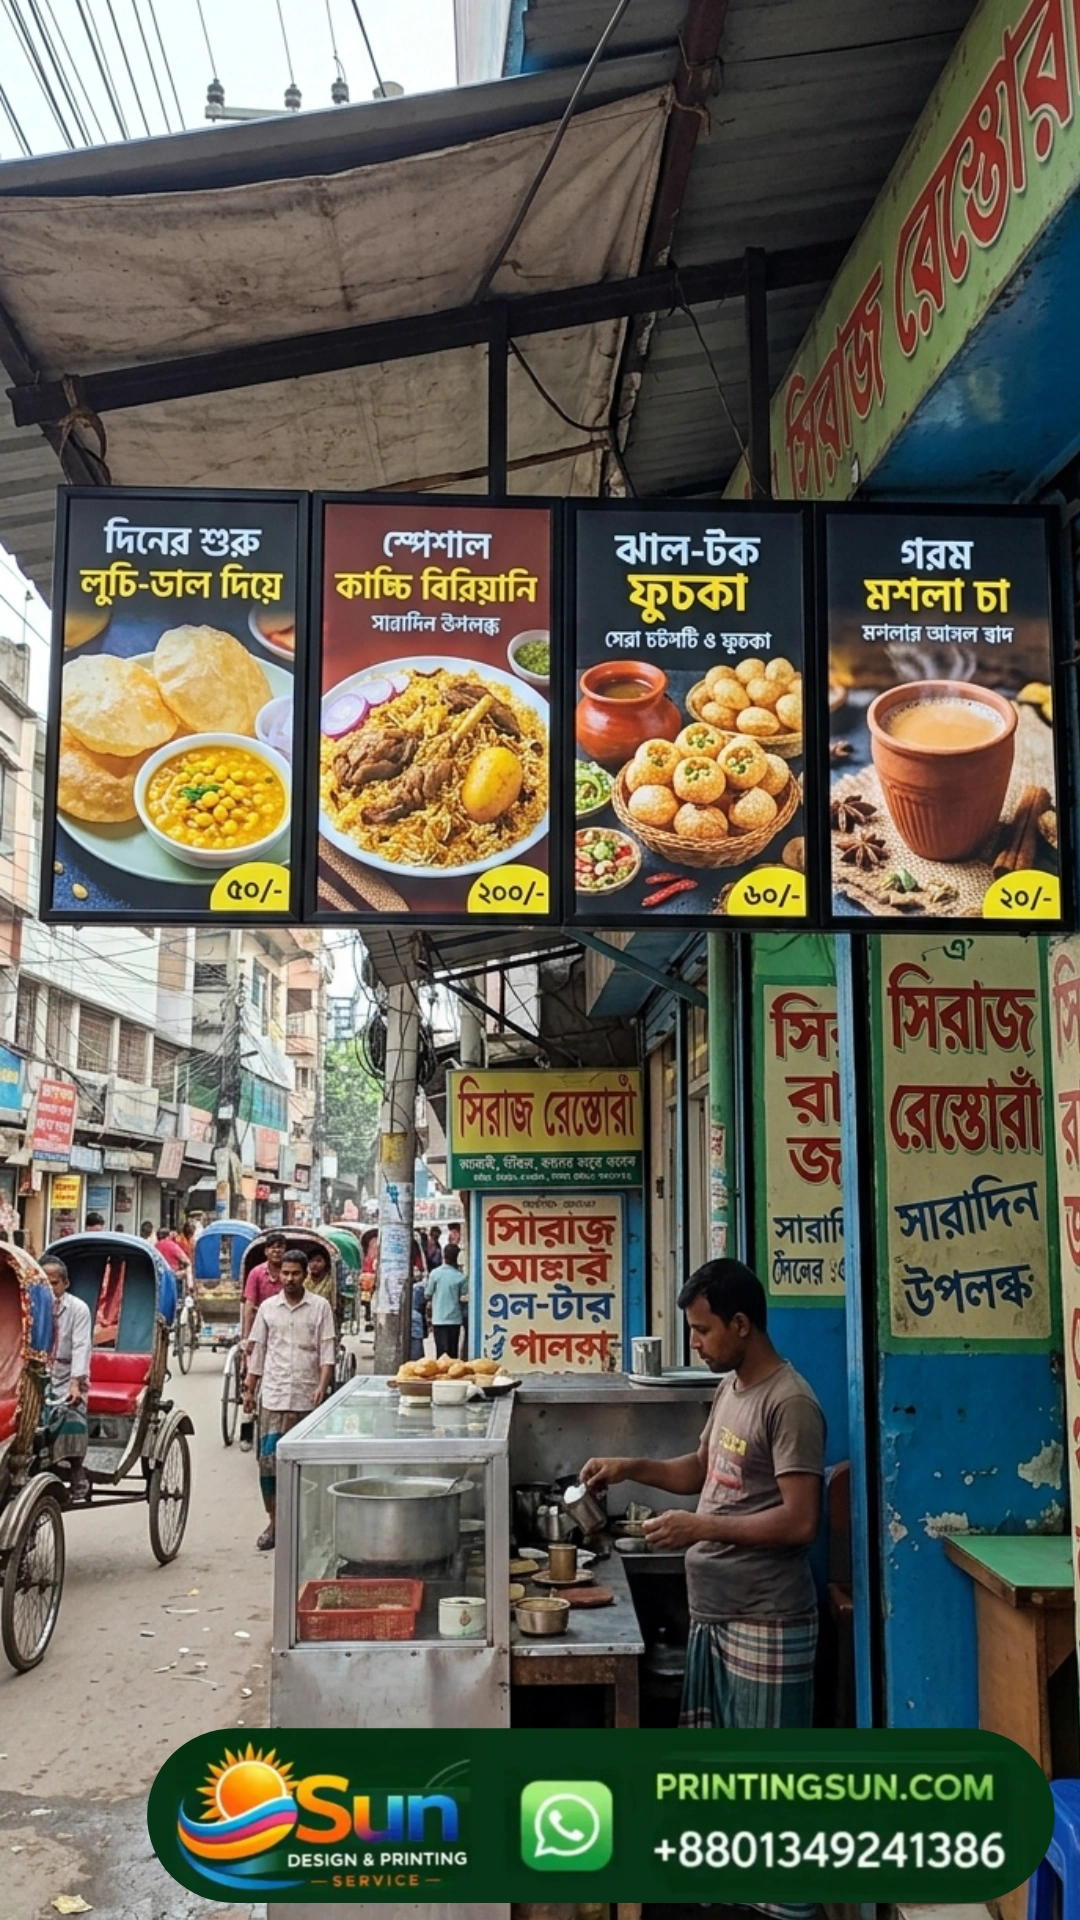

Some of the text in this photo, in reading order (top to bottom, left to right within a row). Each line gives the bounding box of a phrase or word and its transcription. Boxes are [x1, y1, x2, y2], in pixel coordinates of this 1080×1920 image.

[104, 517, 262, 557] দিনের শুরু
[383, 530, 492, 560] স্পেশাল
[614, 529, 761, 566] ঝাল-টক
[901, 537, 974, 571] গরম
[80, 561, 283, 606] লুচি-ডাল দিয়ে
[334, 565, 538, 605] কাচ্চি বিরিয়ানি
[627, 573, 748, 624] ফুচকা
[864, 577, 1011, 613] মশলা চা
[703, 633, 716, 649] ও
[227, 879, 282, 903] ৫০/-
[478, 881, 544, 905] ২০০/-
[744, 884, 800, 908] ৬০/-
[1000, 886, 1051, 911] ২০/-
[770, 992, 839, 1058] সি
[887, 962, 1036, 1053] সিরাজ
[457, 1075, 534, 1137] সিরাজ
[890, 1066, 1042, 1150] রেস্তোরাঁ
[894, 1175, 1039, 1241] সারাদিন
